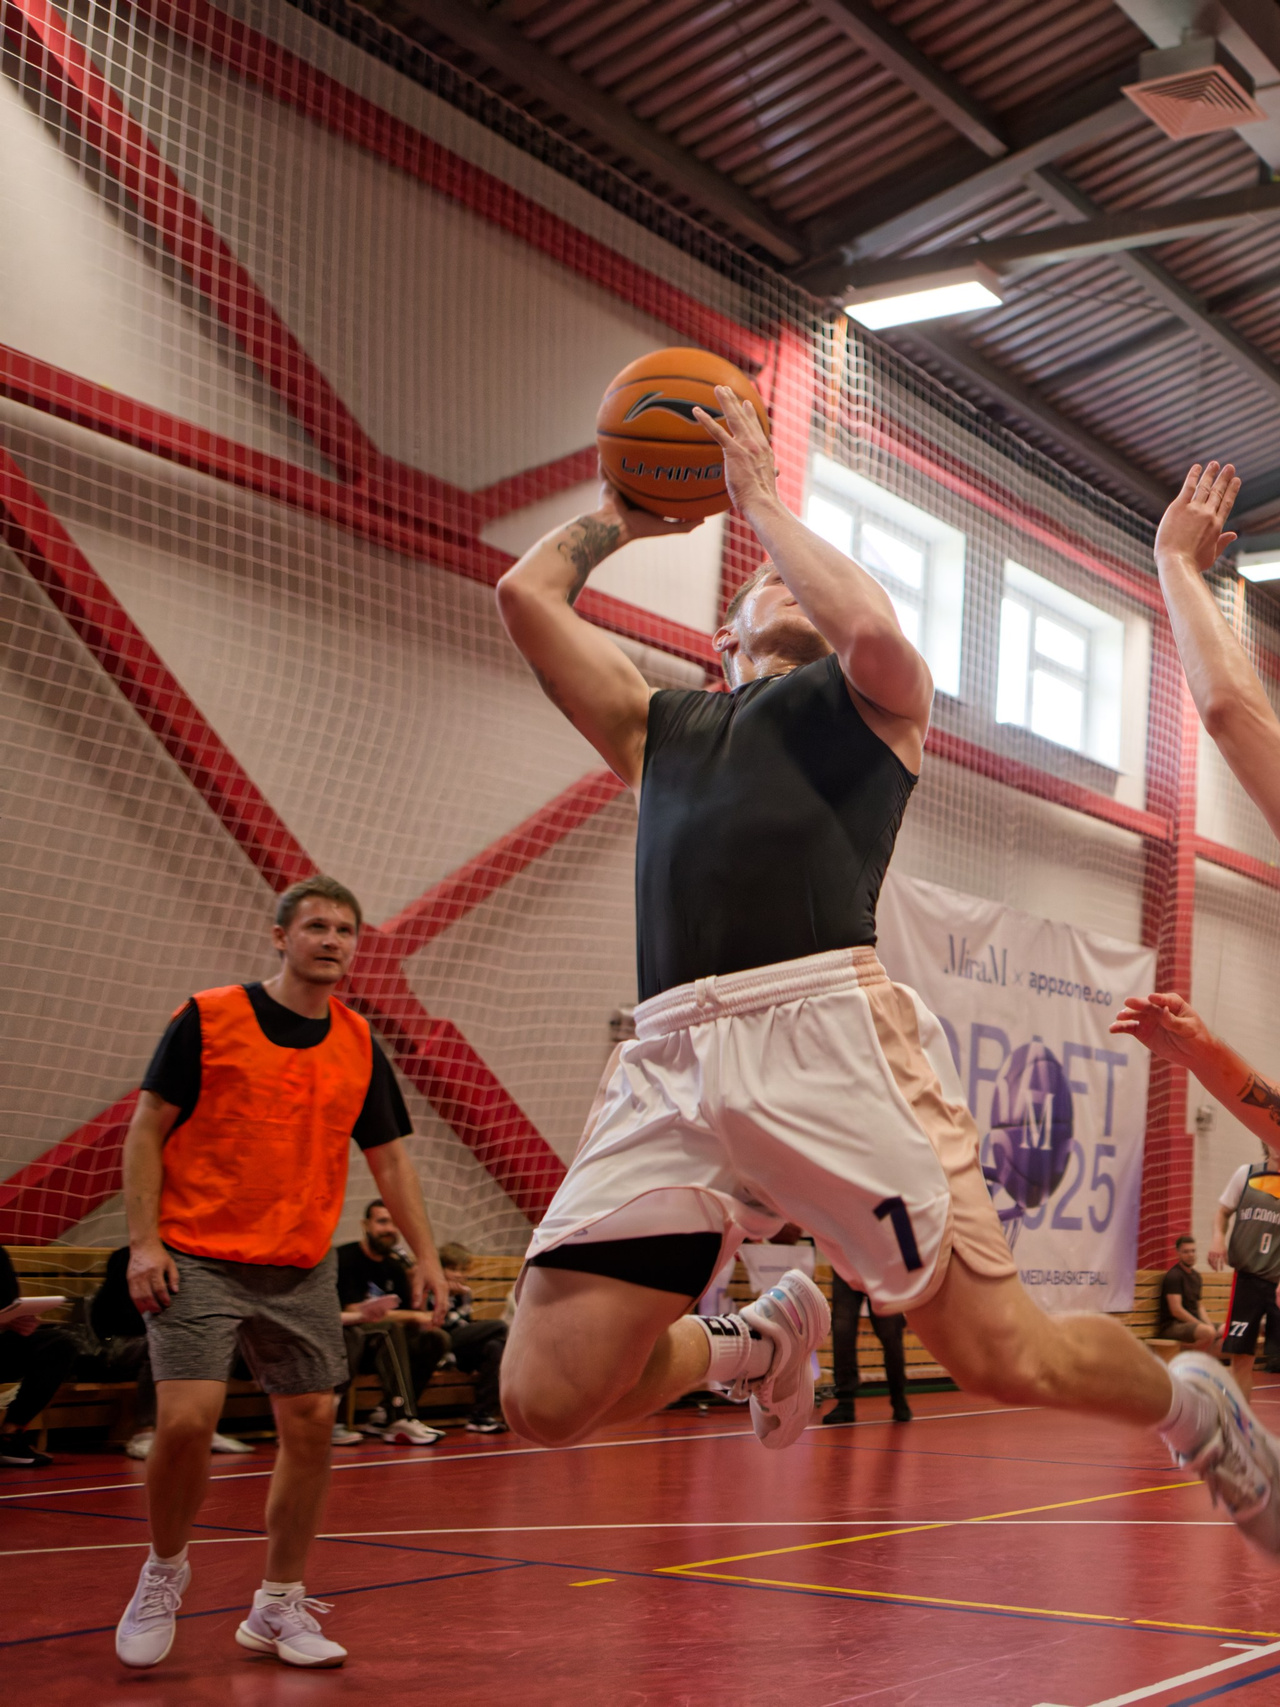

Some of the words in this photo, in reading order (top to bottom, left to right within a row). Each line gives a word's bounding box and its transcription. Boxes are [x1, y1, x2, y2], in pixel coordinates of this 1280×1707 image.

[943, 934, 1008, 986] MiraM
[1029, 971, 1113, 1007] appzone.co
[872, 1195, 924, 1274] 1
[1229, 1321, 1249, 1337] 77
